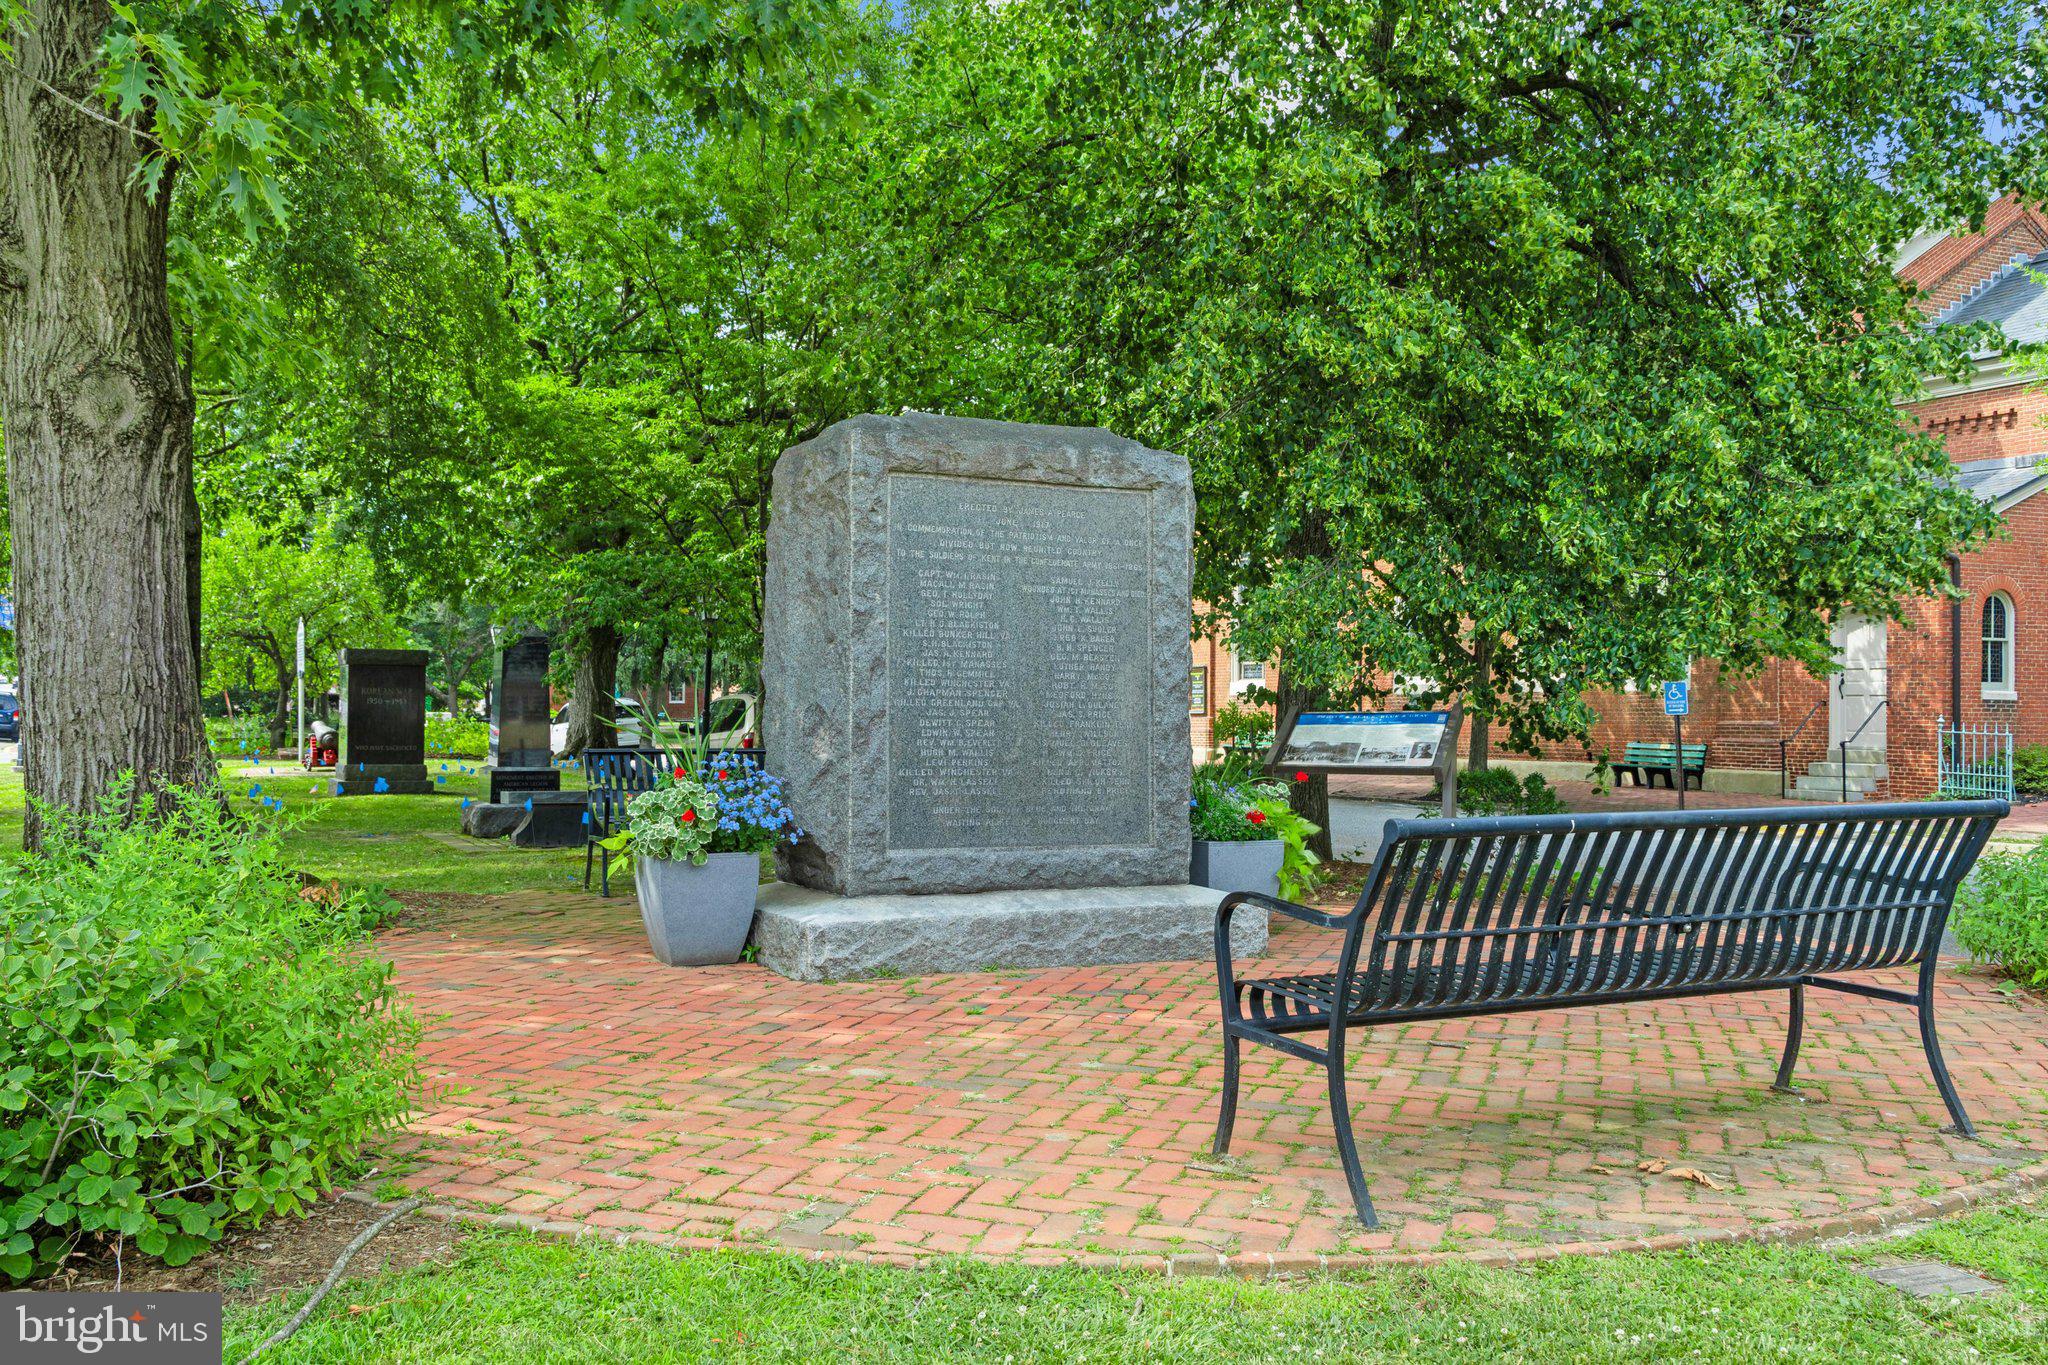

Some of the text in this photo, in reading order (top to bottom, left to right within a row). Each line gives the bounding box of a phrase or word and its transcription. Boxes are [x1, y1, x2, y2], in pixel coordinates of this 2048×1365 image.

[959, 503, 997, 513] ERECTED
[1058, 509, 1086, 519] PEARCE
[908, 523, 974, 537] COMMEMORATION
[990, 530, 1005, 539] THE
[1009, 531, 1054, 543] PATRIOTISM
[1057, 533, 1072, 544] AND
[940, 539, 974, 549] DIVIDED
[979, 542, 995, 550] BUT
[1000, 543, 1018, 552] NOW
[1023, 544, 1063, 555] REUNITED
[896, 548, 906, 557] TO
[910, 550, 925, 559] THE
[929, 551, 965, 562] SOLDIERS
[981, 554, 1000, 564] KENT
[1030, 557, 1079, 568] CONFEDERATE
[1050, 577, 1083, 586] SAMUEL
[969, 582, 995, 591] RASIN
[1050, 596, 1072, 604] JOHN
[952, 601, 984, 610] WRIGHT
[903, 630, 935, 638] KILLED
[939, 631, 973, 639] BUNKER
[1077, 644, 1114, 653] SPENCER
[953, 650, 993, 658] KENNARD
[906, 659, 939, 667] KILLED
[961, 660, 1007, 669] MANASSES
[904, 678, 996, 687] KILLED WINCHESTER
[918, 689, 962, 697] CHAPMAN
[967, 689, 1008, 698] SPENCER
[931, 699, 984, 708] GREENLAND
[960, 709, 989, 717] SPEAR
[1088, 711, 1112, 719] PRICE
[919, 719, 953, 727] DEWITT
[966, 719, 995, 727] SPEAR
[921, 729, 948, 737] EDWIN
[965, 729, 995, 737] SPEAR
[920, 749, 945, 757] HUGH
[962, 749, 994, 757] WALLIS
[951, 759, 989, 767] PERKINS
[898, 768, 998, 776] KILLED WINCHESTER
[933, 806, 960, 814] UNDER
[946, 818, 981, 827] WAITING
